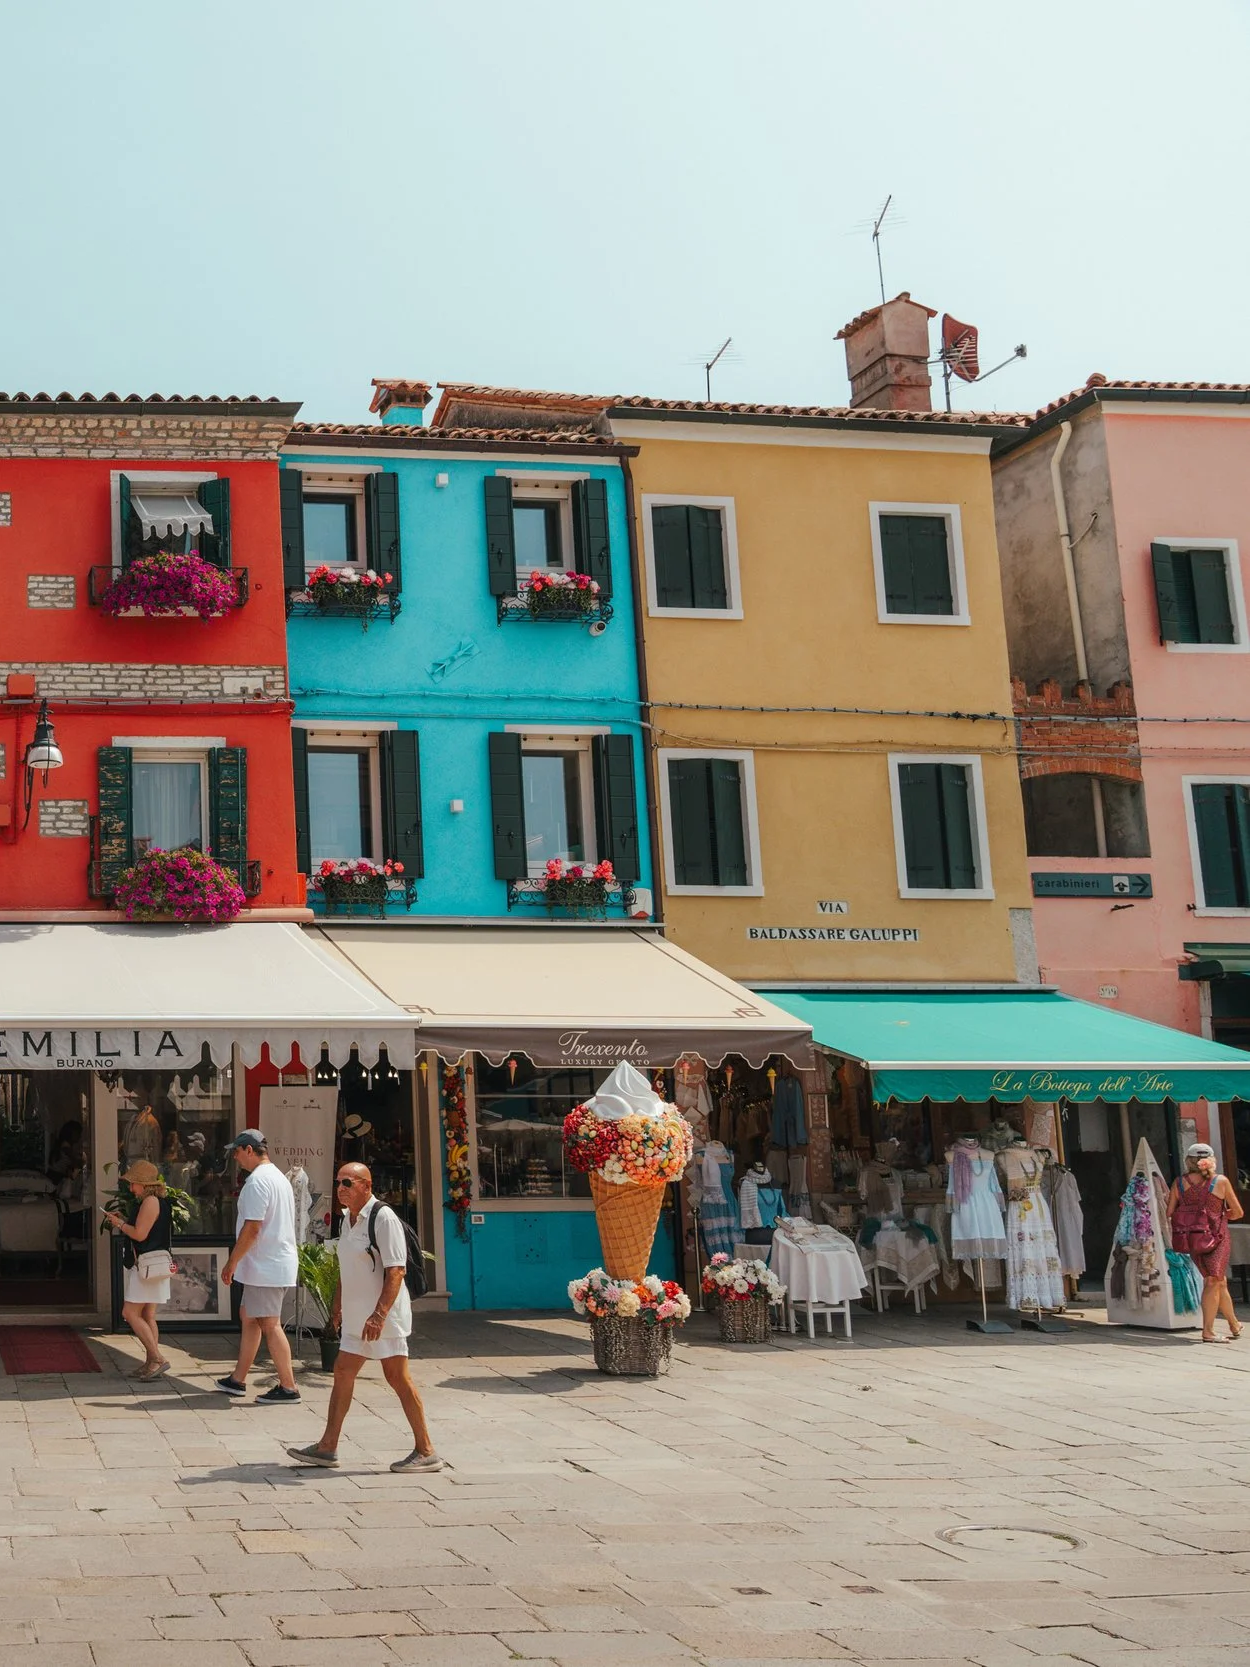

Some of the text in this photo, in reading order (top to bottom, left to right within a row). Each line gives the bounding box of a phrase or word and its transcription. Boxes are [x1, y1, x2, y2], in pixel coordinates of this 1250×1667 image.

[1037, 878, 1100, 889] carabinieri
[818, 902, 845, 913] VIA
[749, 928, 919, 941] BALDASSARE GALUPPI
[558, 1030, 647, 1056] Trexento
[56, 1058, 114, 1068] BURANO
[607, 1058, 650, 1066] GEATO
[989, 1070, 1023, 1092] La
[1028, 1070, 1093, 1099] Bottega
[1133, 1070, 1175, 1092] Arte
[274, 1146, 324, 1157] WEDDING
